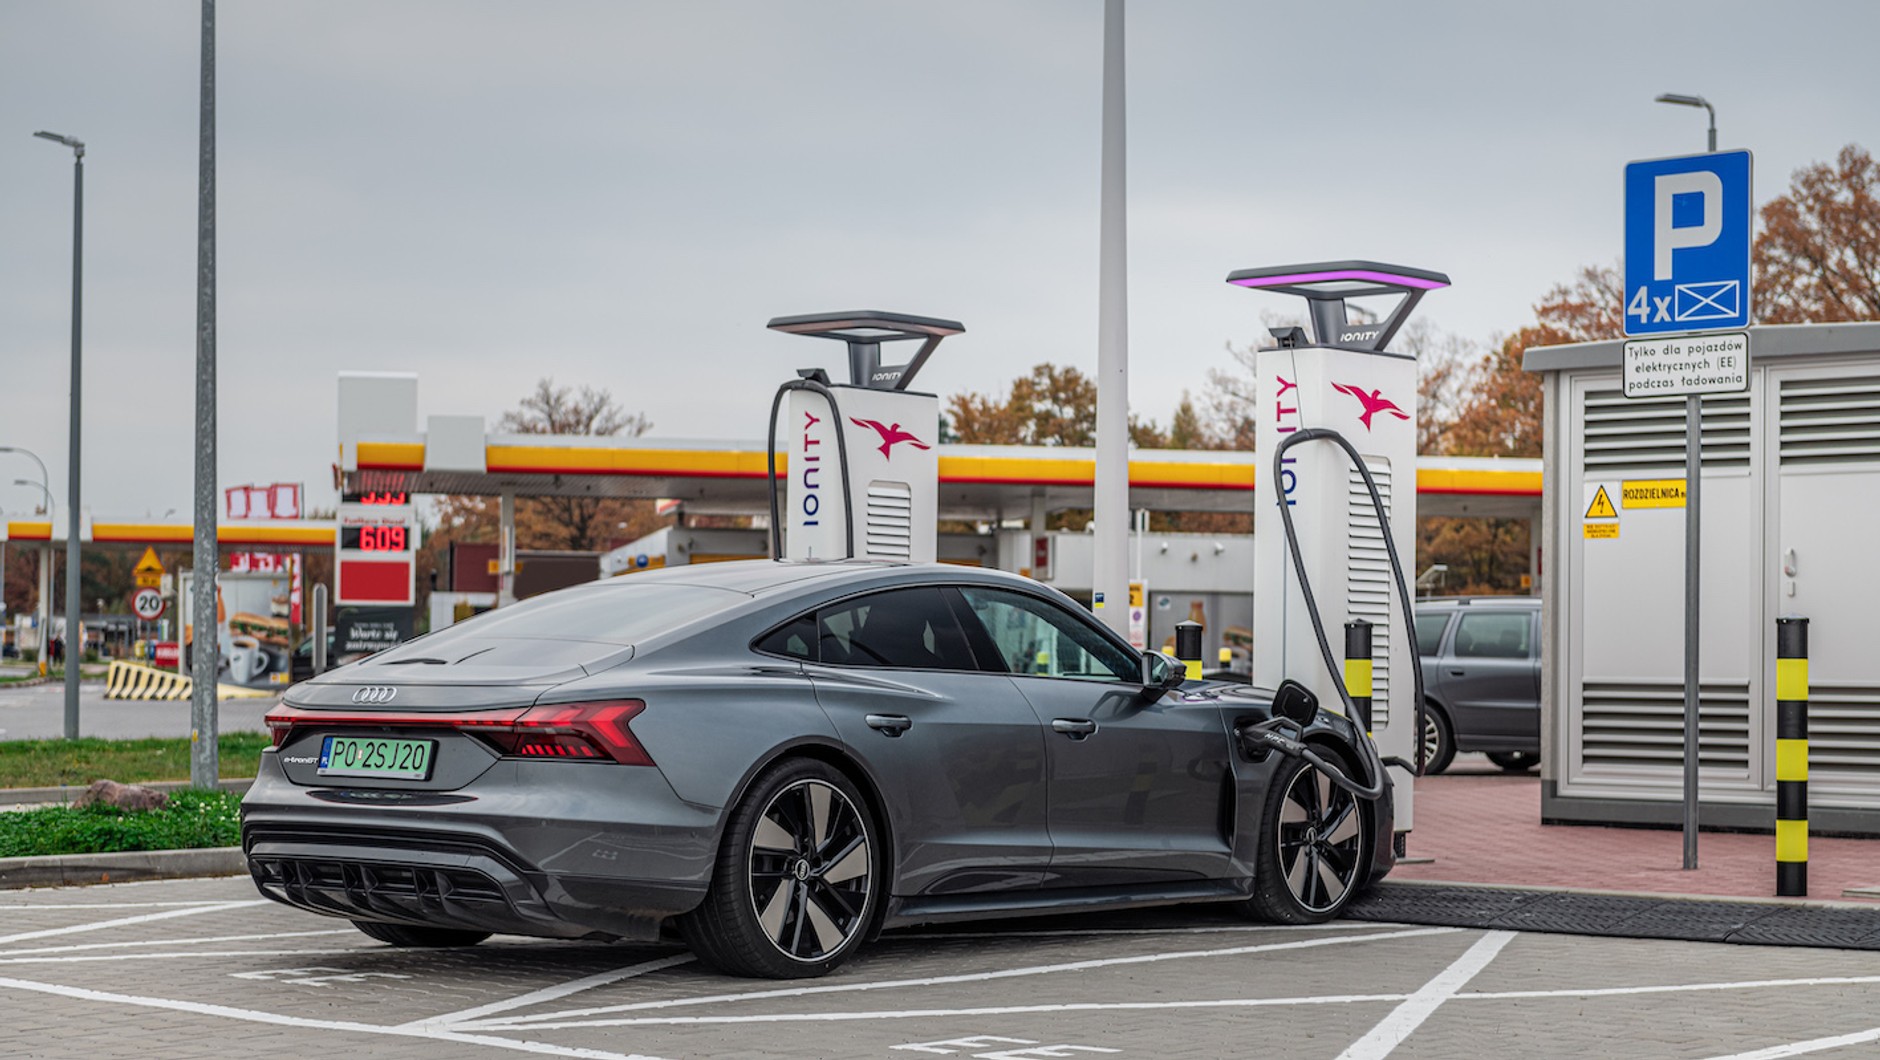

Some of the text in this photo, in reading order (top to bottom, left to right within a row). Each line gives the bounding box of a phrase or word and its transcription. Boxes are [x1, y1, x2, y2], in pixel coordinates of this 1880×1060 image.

[1654, 170, 1723, 281] P
[1627, 285, 1672, 324] 4x
[1340, 331, 1379, 342] IONITY
[1628, 341, 1743, 360] Tylko dla pojazdów
[1635, 356, 1737, 374] elektrycznych (EE)
[1629, 373, 1743, 392] podczas ładowania
[803, 411, 820, 526] IONITY
[1623, 487, 1679, 500] ROZDZIELNICA
[360, 526, 405, 552] 609
[139, 595, 159, 611] 20
[332, 741, 424, 770] PO 2SJ20
